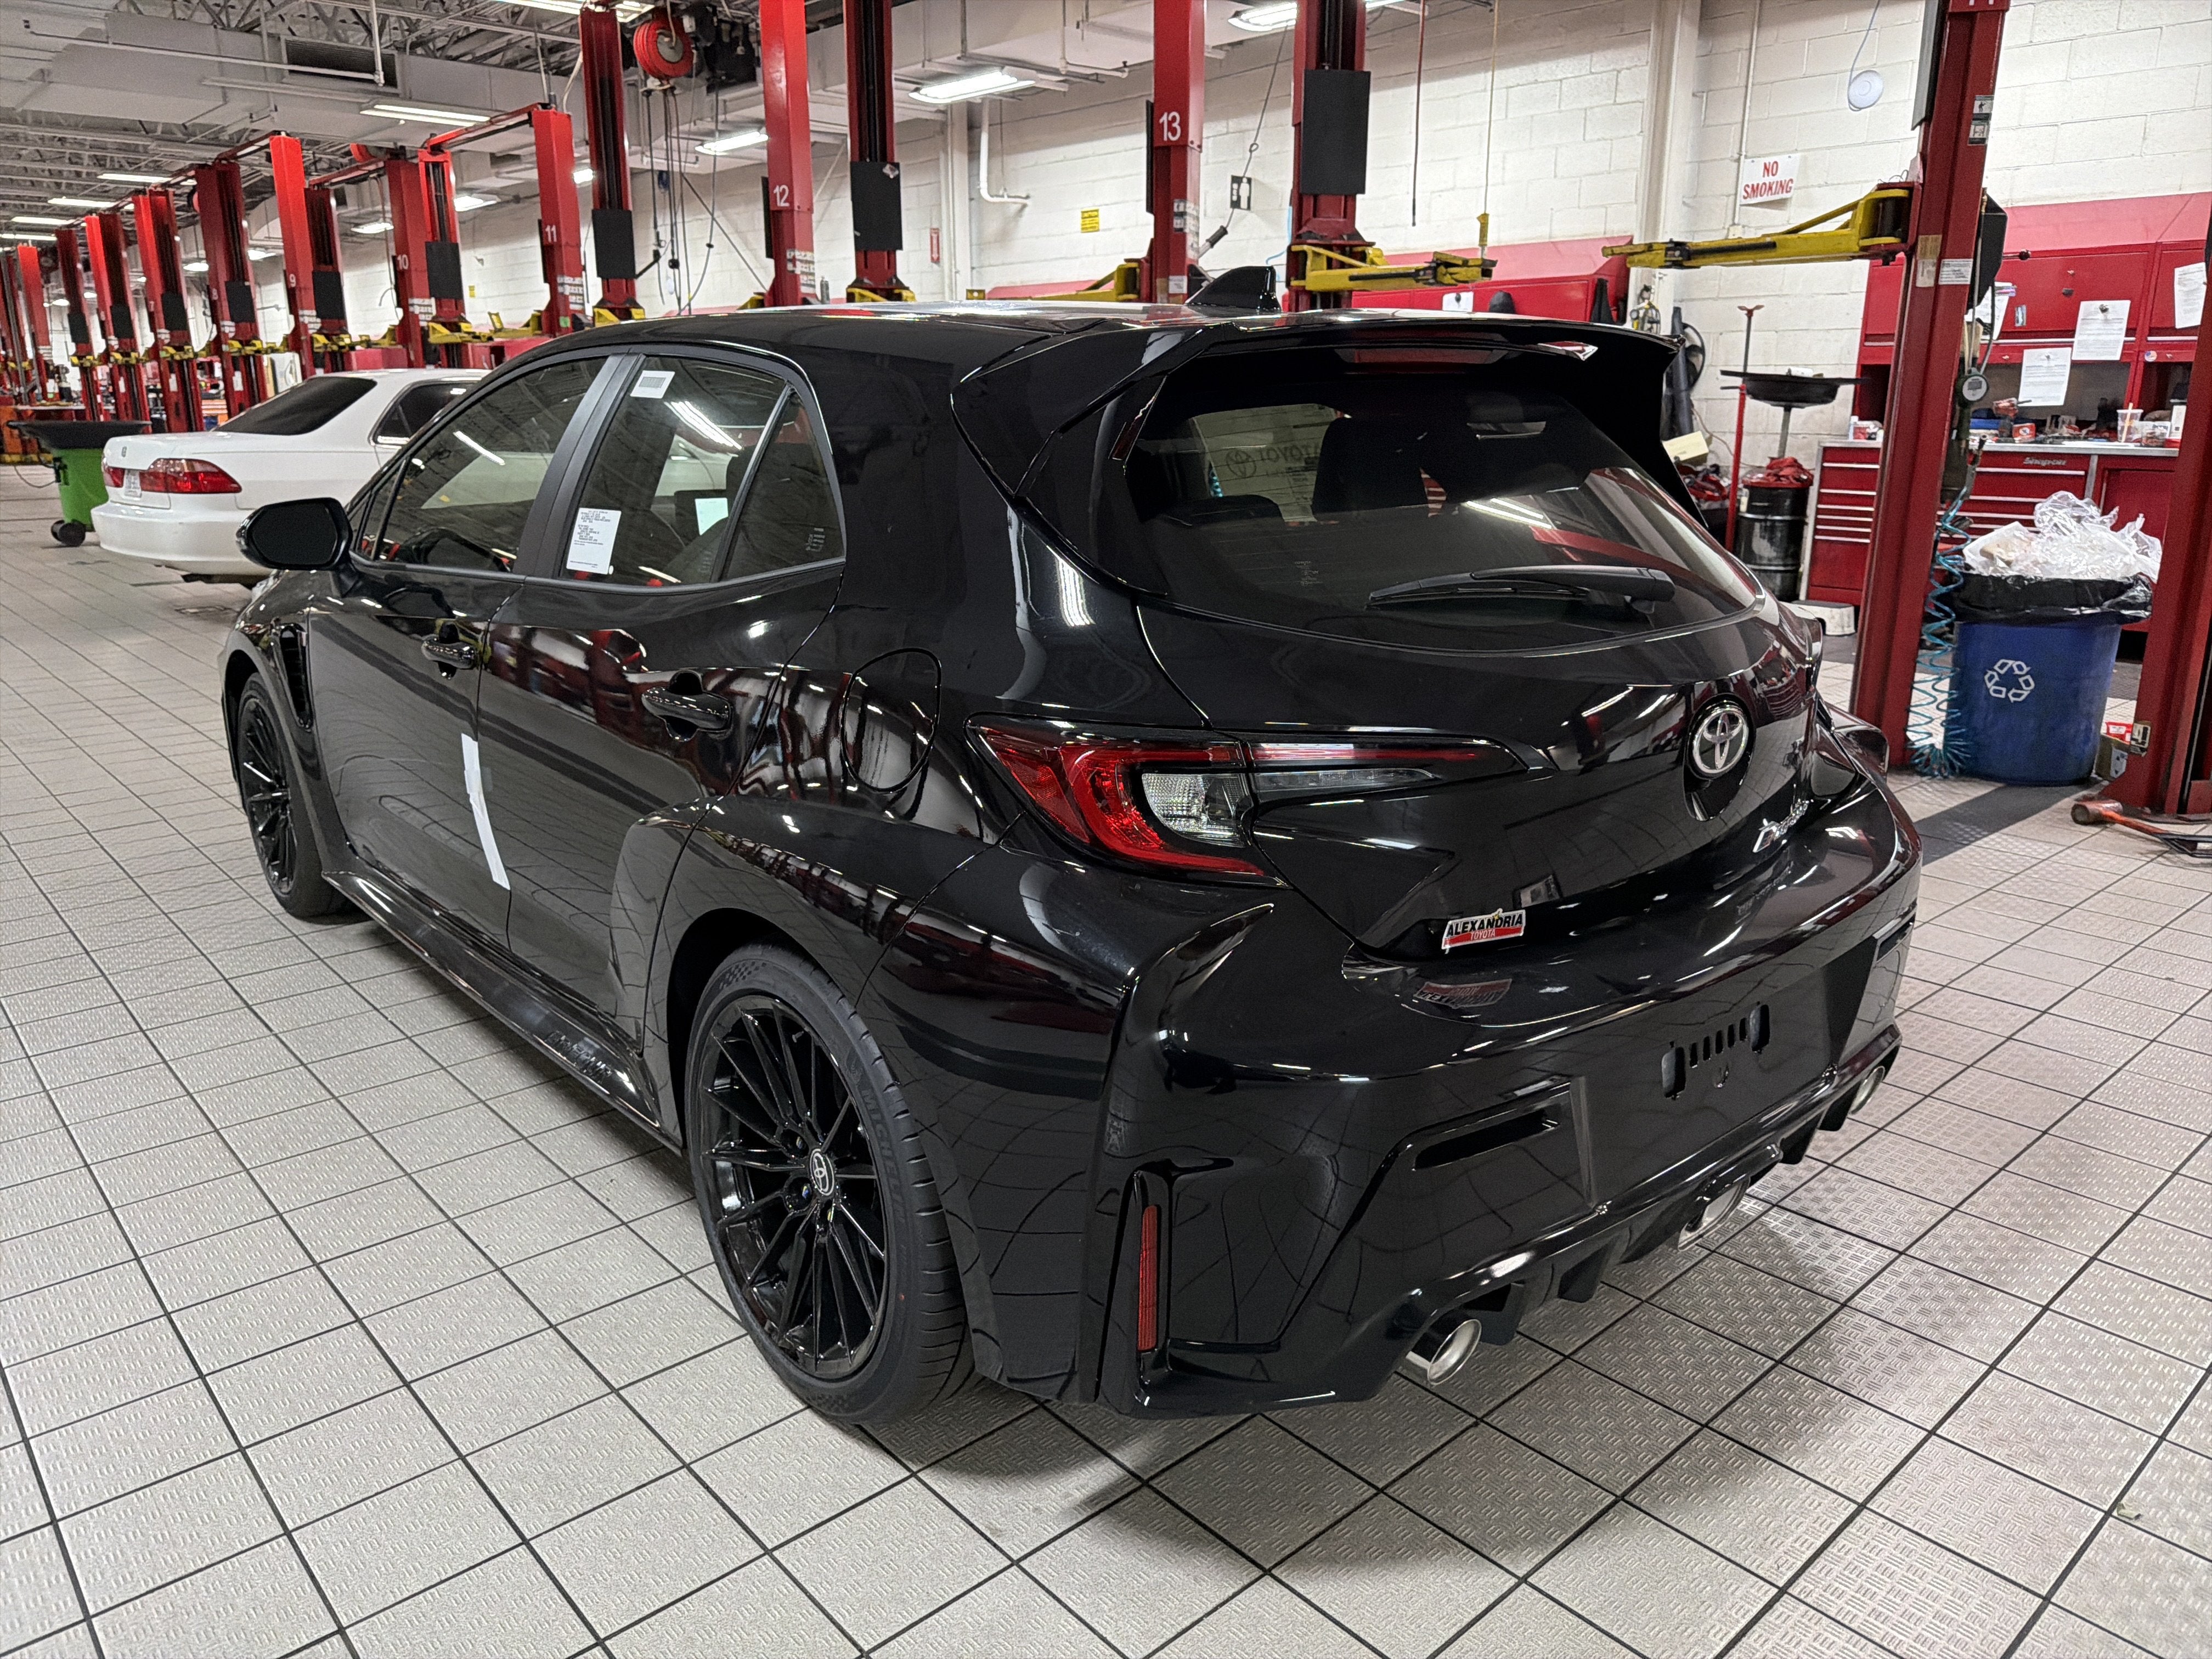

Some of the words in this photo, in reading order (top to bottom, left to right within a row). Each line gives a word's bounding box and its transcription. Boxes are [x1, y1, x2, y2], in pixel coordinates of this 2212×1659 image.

[1159, 111, 1181, 141] 13
[1762, 161, 1779, 178] NO
[774, 185, 790, 207] 12
[1742, 178, 1794, 200] SMOKING
[545, 224, 557, 243] 11
[397, 254, 409, 270] 10
[289, 273, 297, 287] 9
[1445, 913, 1523, 938] ALEXANDRIA
[1470, 928, 1496, 941] TOYOTA
